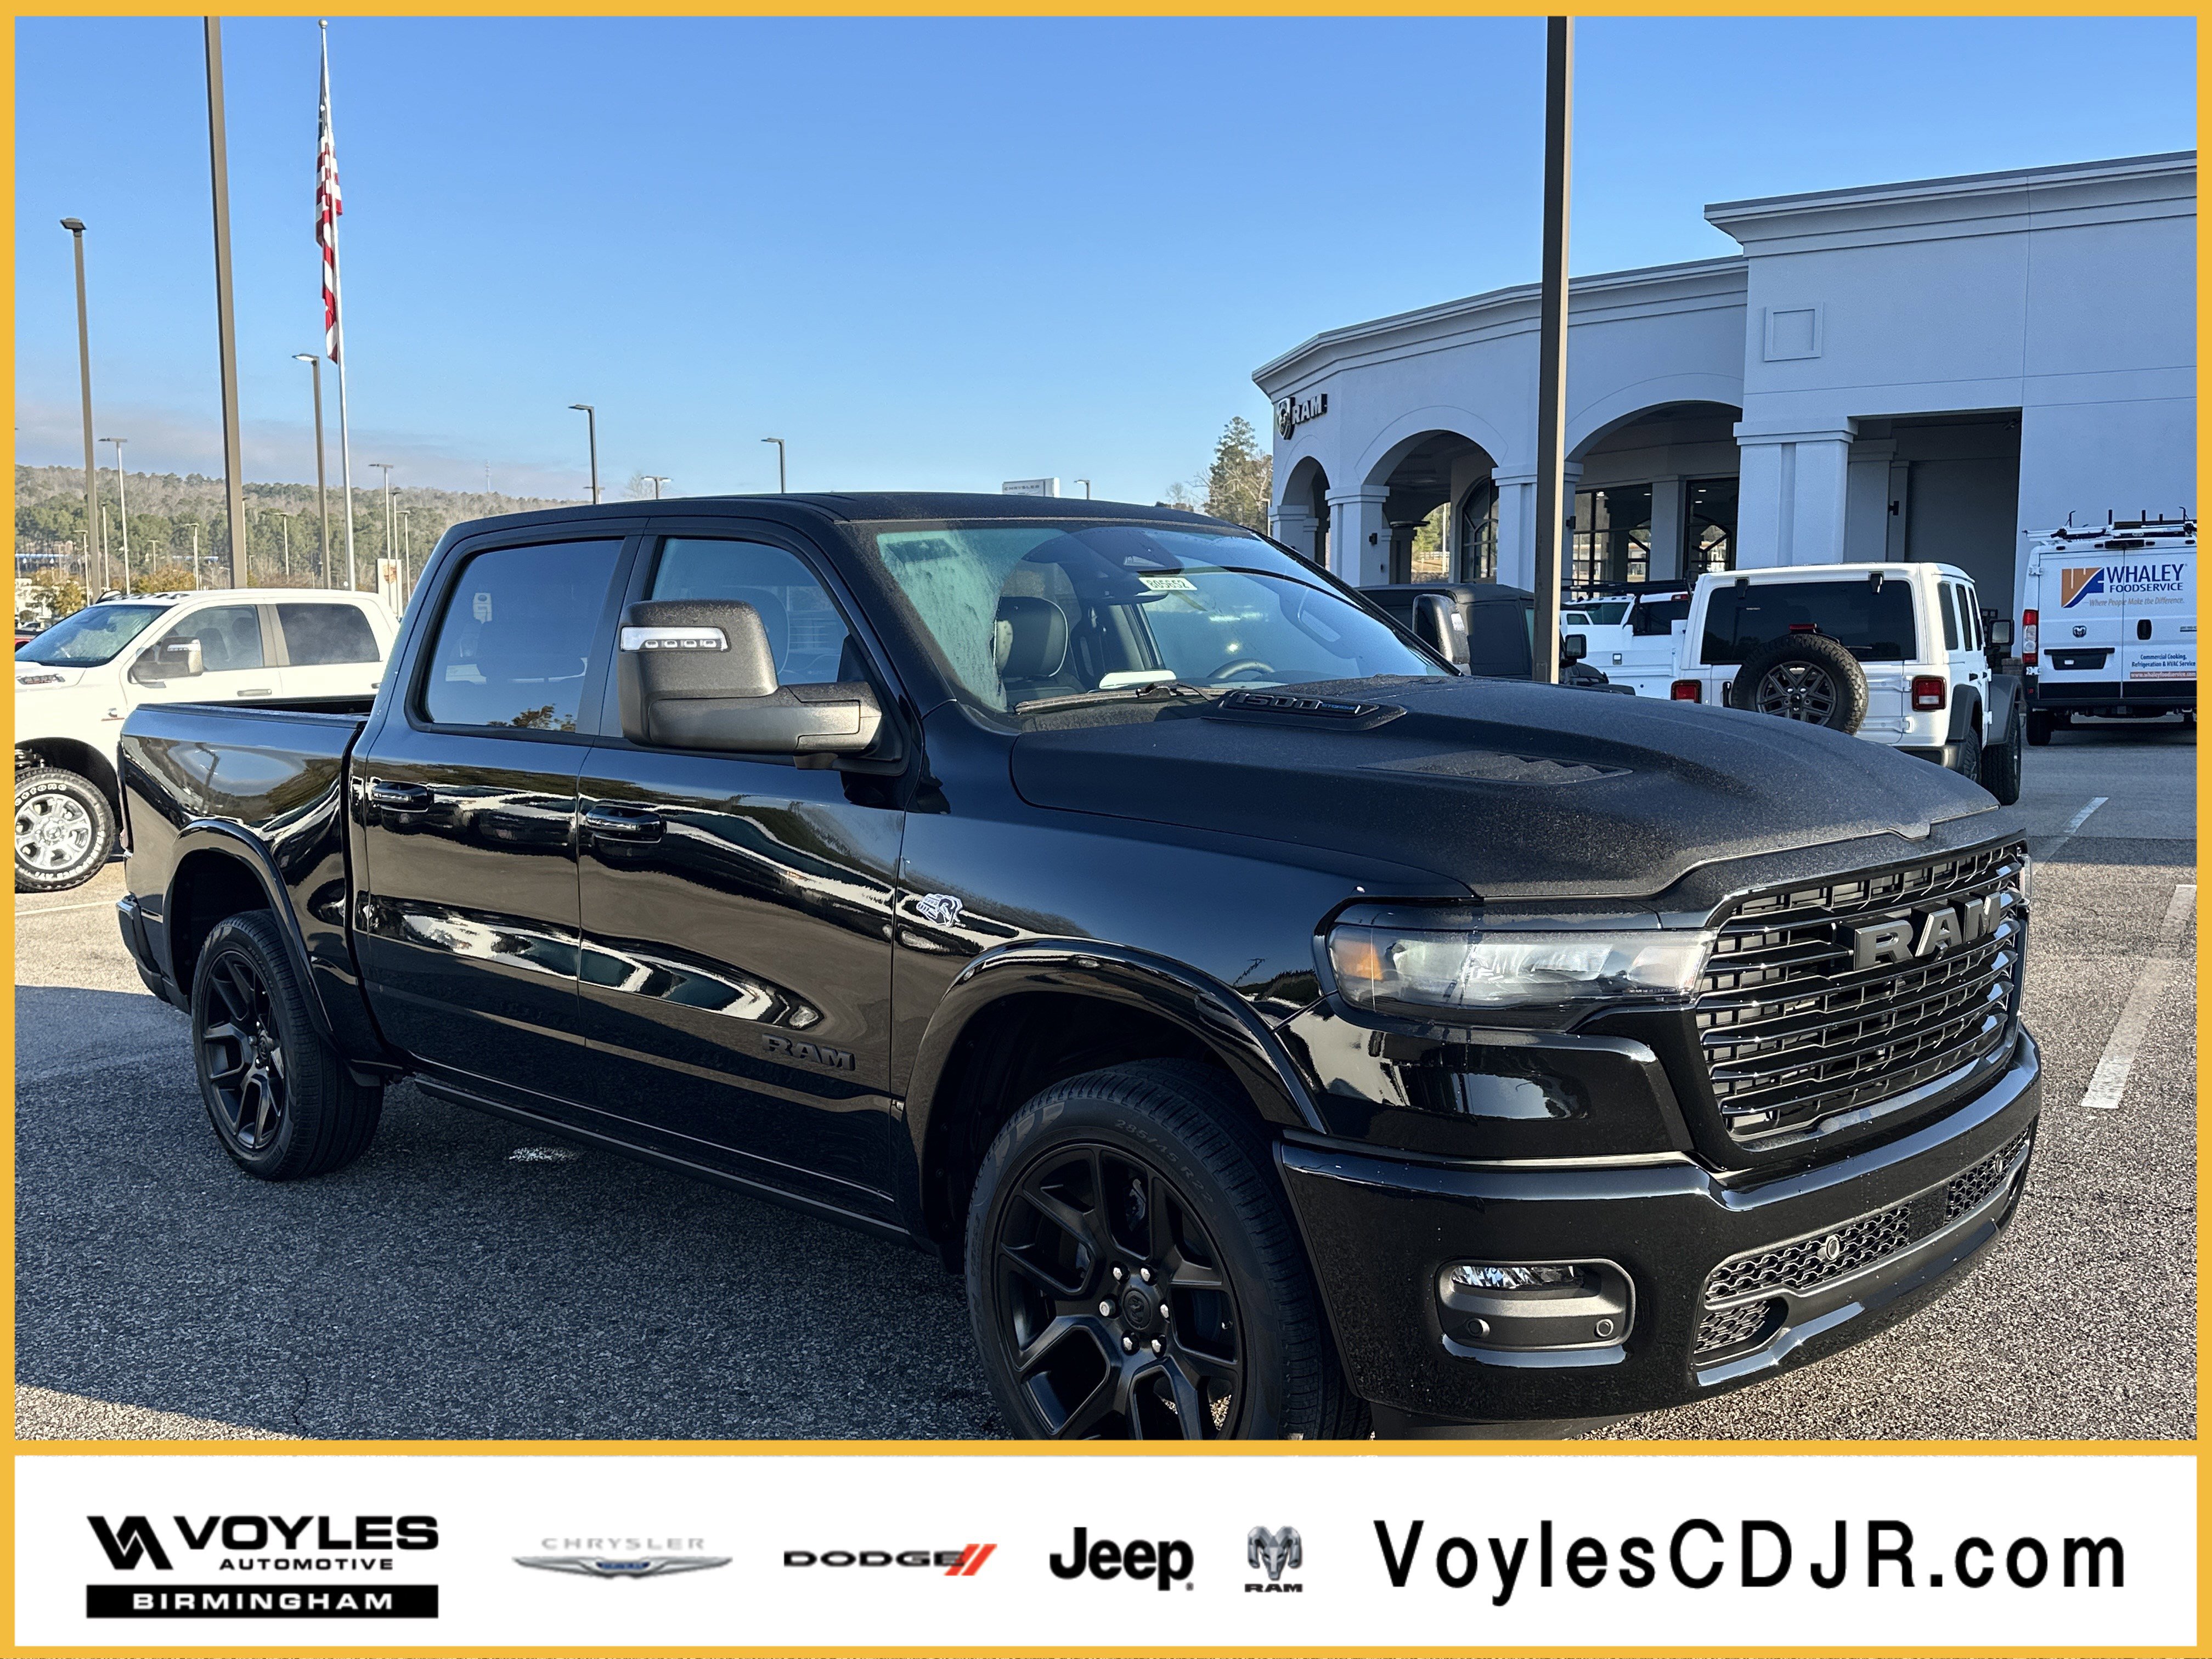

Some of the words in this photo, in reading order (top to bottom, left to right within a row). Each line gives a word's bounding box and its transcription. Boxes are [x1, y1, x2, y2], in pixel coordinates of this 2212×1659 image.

[1291, 393, 1327, 425] RAM
[2107, 563, 2185, 583] WHALEY
[2109, 583, 2183, 593] FOODSERVICE
[1235, 692, 1323, 710] 1500
[1854, 892, 2001, 971] RAM
[761, 1033, 855, 1071] RAM
